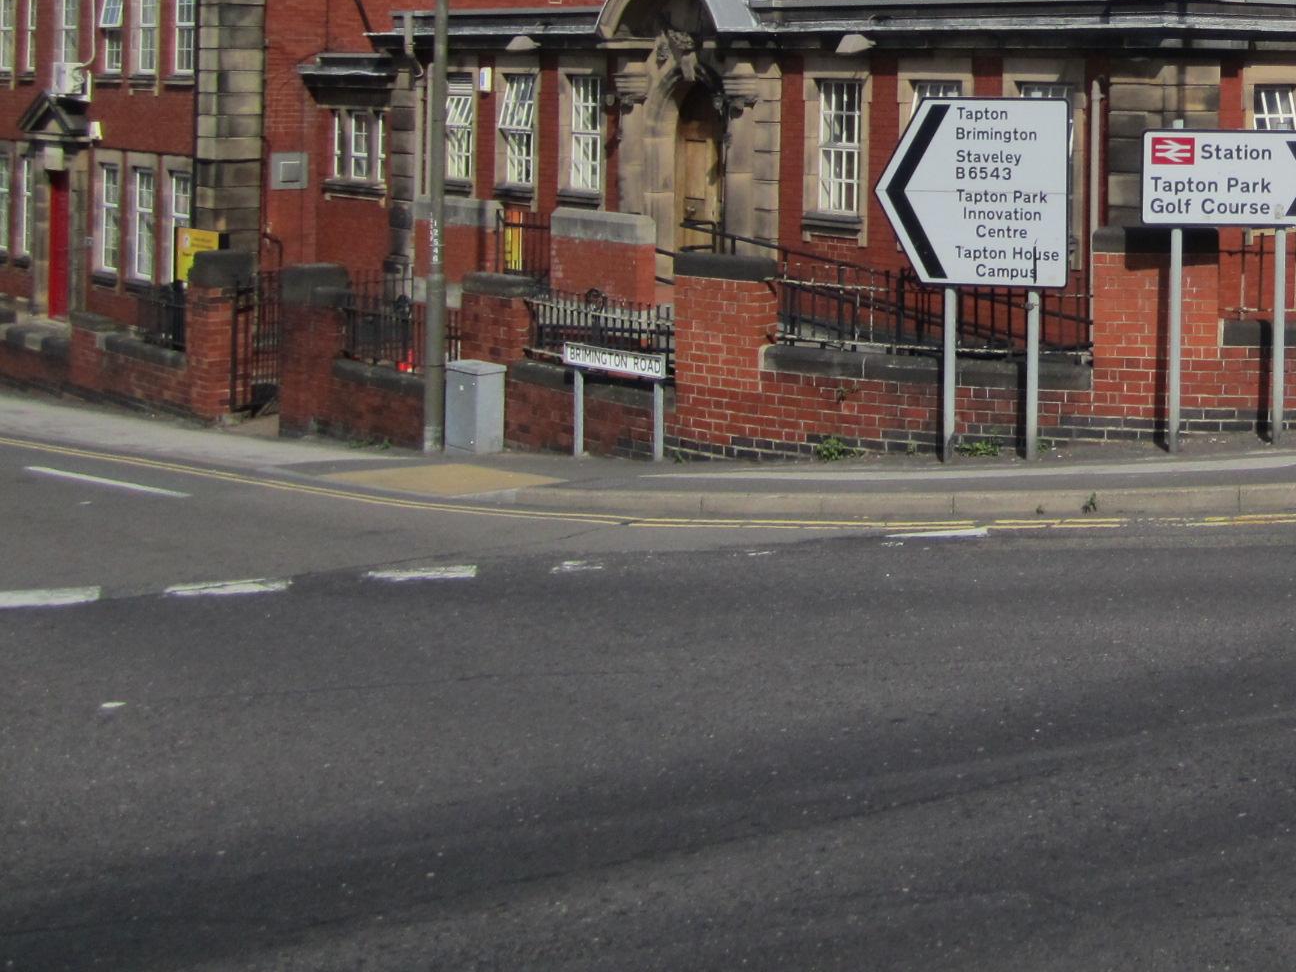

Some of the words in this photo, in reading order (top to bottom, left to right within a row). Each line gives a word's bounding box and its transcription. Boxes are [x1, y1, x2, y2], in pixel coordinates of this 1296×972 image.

[956, 107, 1008, 122] Tapton
[955, 127, 1037, 143] Brimington
[956, 149, 1022, 166] Staveley
[1201, 144, 1272, 160] Station
[955, 166, 1012, 180] B6543
[1150, 176, 1218, 195] Tapton
[1227, 177, 1271, 193] Park
[956, 189, 1007, 204] Tapton
[1013, 190, 1048, 203] Park
[963, 206, 1042, 221] Innovation
[1150, 197, 1192, 214] Golf
[1201, 198, 1271, 215] Course
[975, 224, 1028, 238] Centre
[955, 245, 1007, 261] Tapton
[1012, 247, 1060, 261] House
[975, 263, 1036, 280] Campus
[570, 347, 628, 368] BRIMINGTON
[633, 358, 660, 373] ROAD
